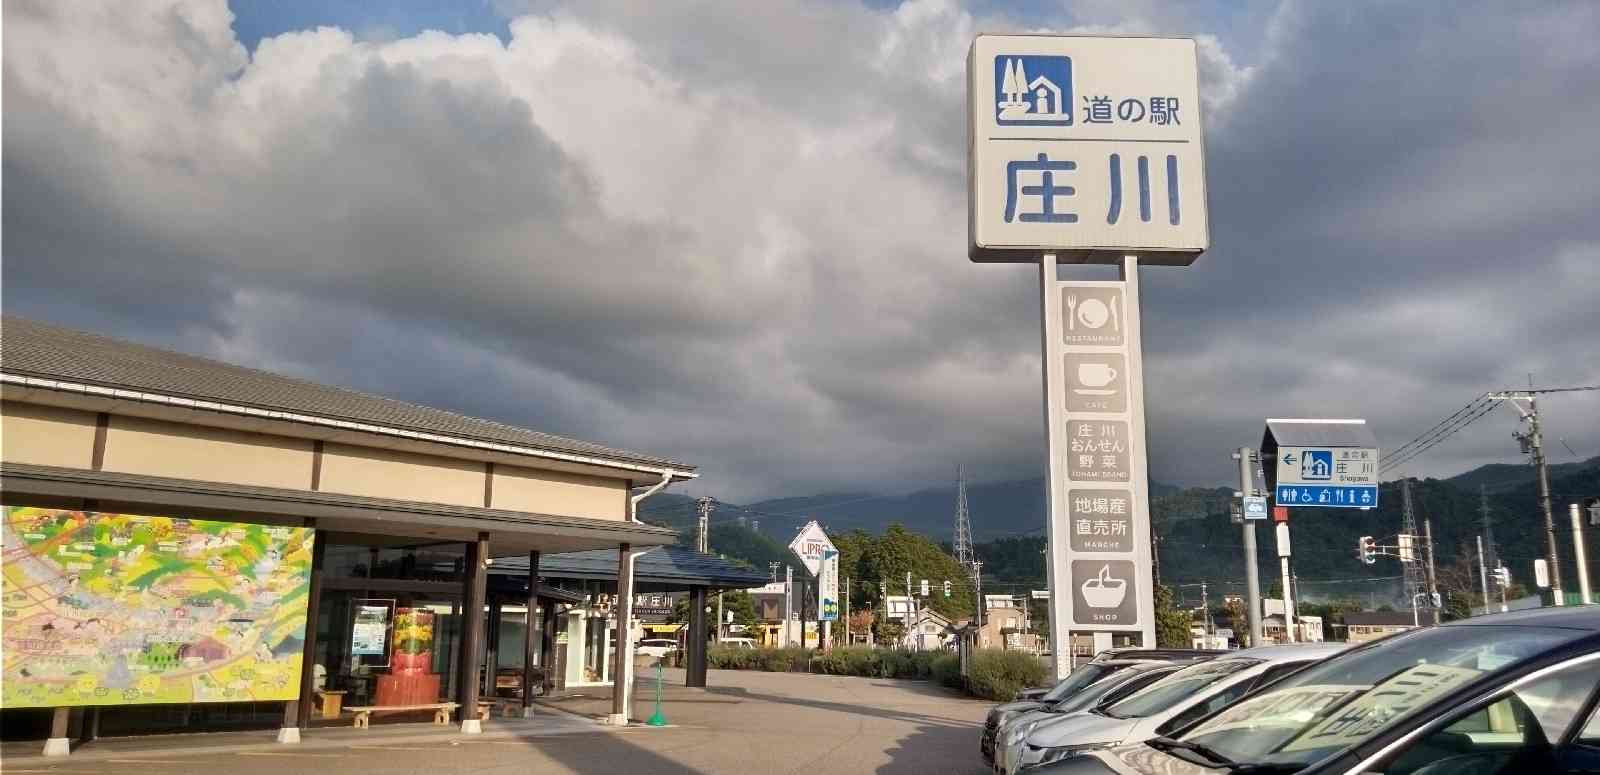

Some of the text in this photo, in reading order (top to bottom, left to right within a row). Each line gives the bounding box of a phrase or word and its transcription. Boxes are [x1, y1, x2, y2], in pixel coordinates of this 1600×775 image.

[1082, 95, 1181, 126] 道の駅
[1004, 152, 1181, 226] 庄川
[1079, 423, 1116, 437] 庄川
[1071, 439, 1125, 453] おんせん
[1079, 455, 1117, 468] 野菜
[1336, 462, 1374, 474] 庄川
[1074, 497, 1127, 514] 地場産
[1076, 519, 1128, 536] 直売所
